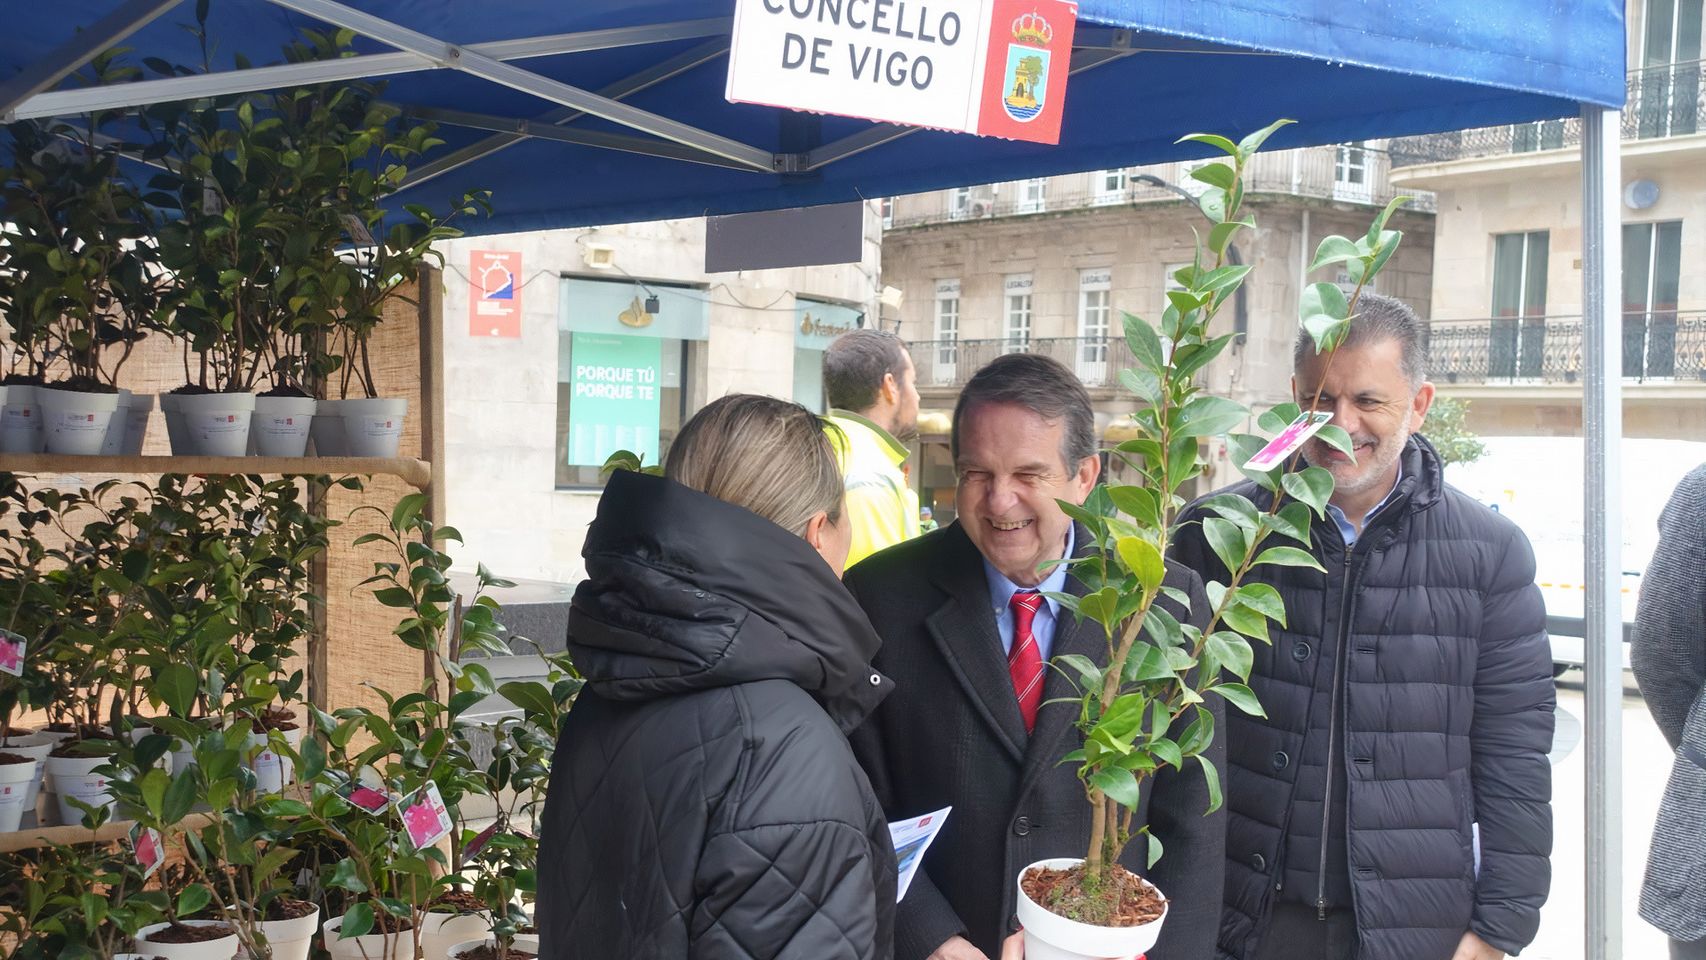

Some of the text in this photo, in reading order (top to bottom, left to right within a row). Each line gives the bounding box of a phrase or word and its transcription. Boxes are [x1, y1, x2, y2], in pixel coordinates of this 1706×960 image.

[782, 32, 933, 90] DE VIGO
[576, 365, 655, 383] PORQUE TÚ
[575, 382, 655, 401] PORQUE TE
